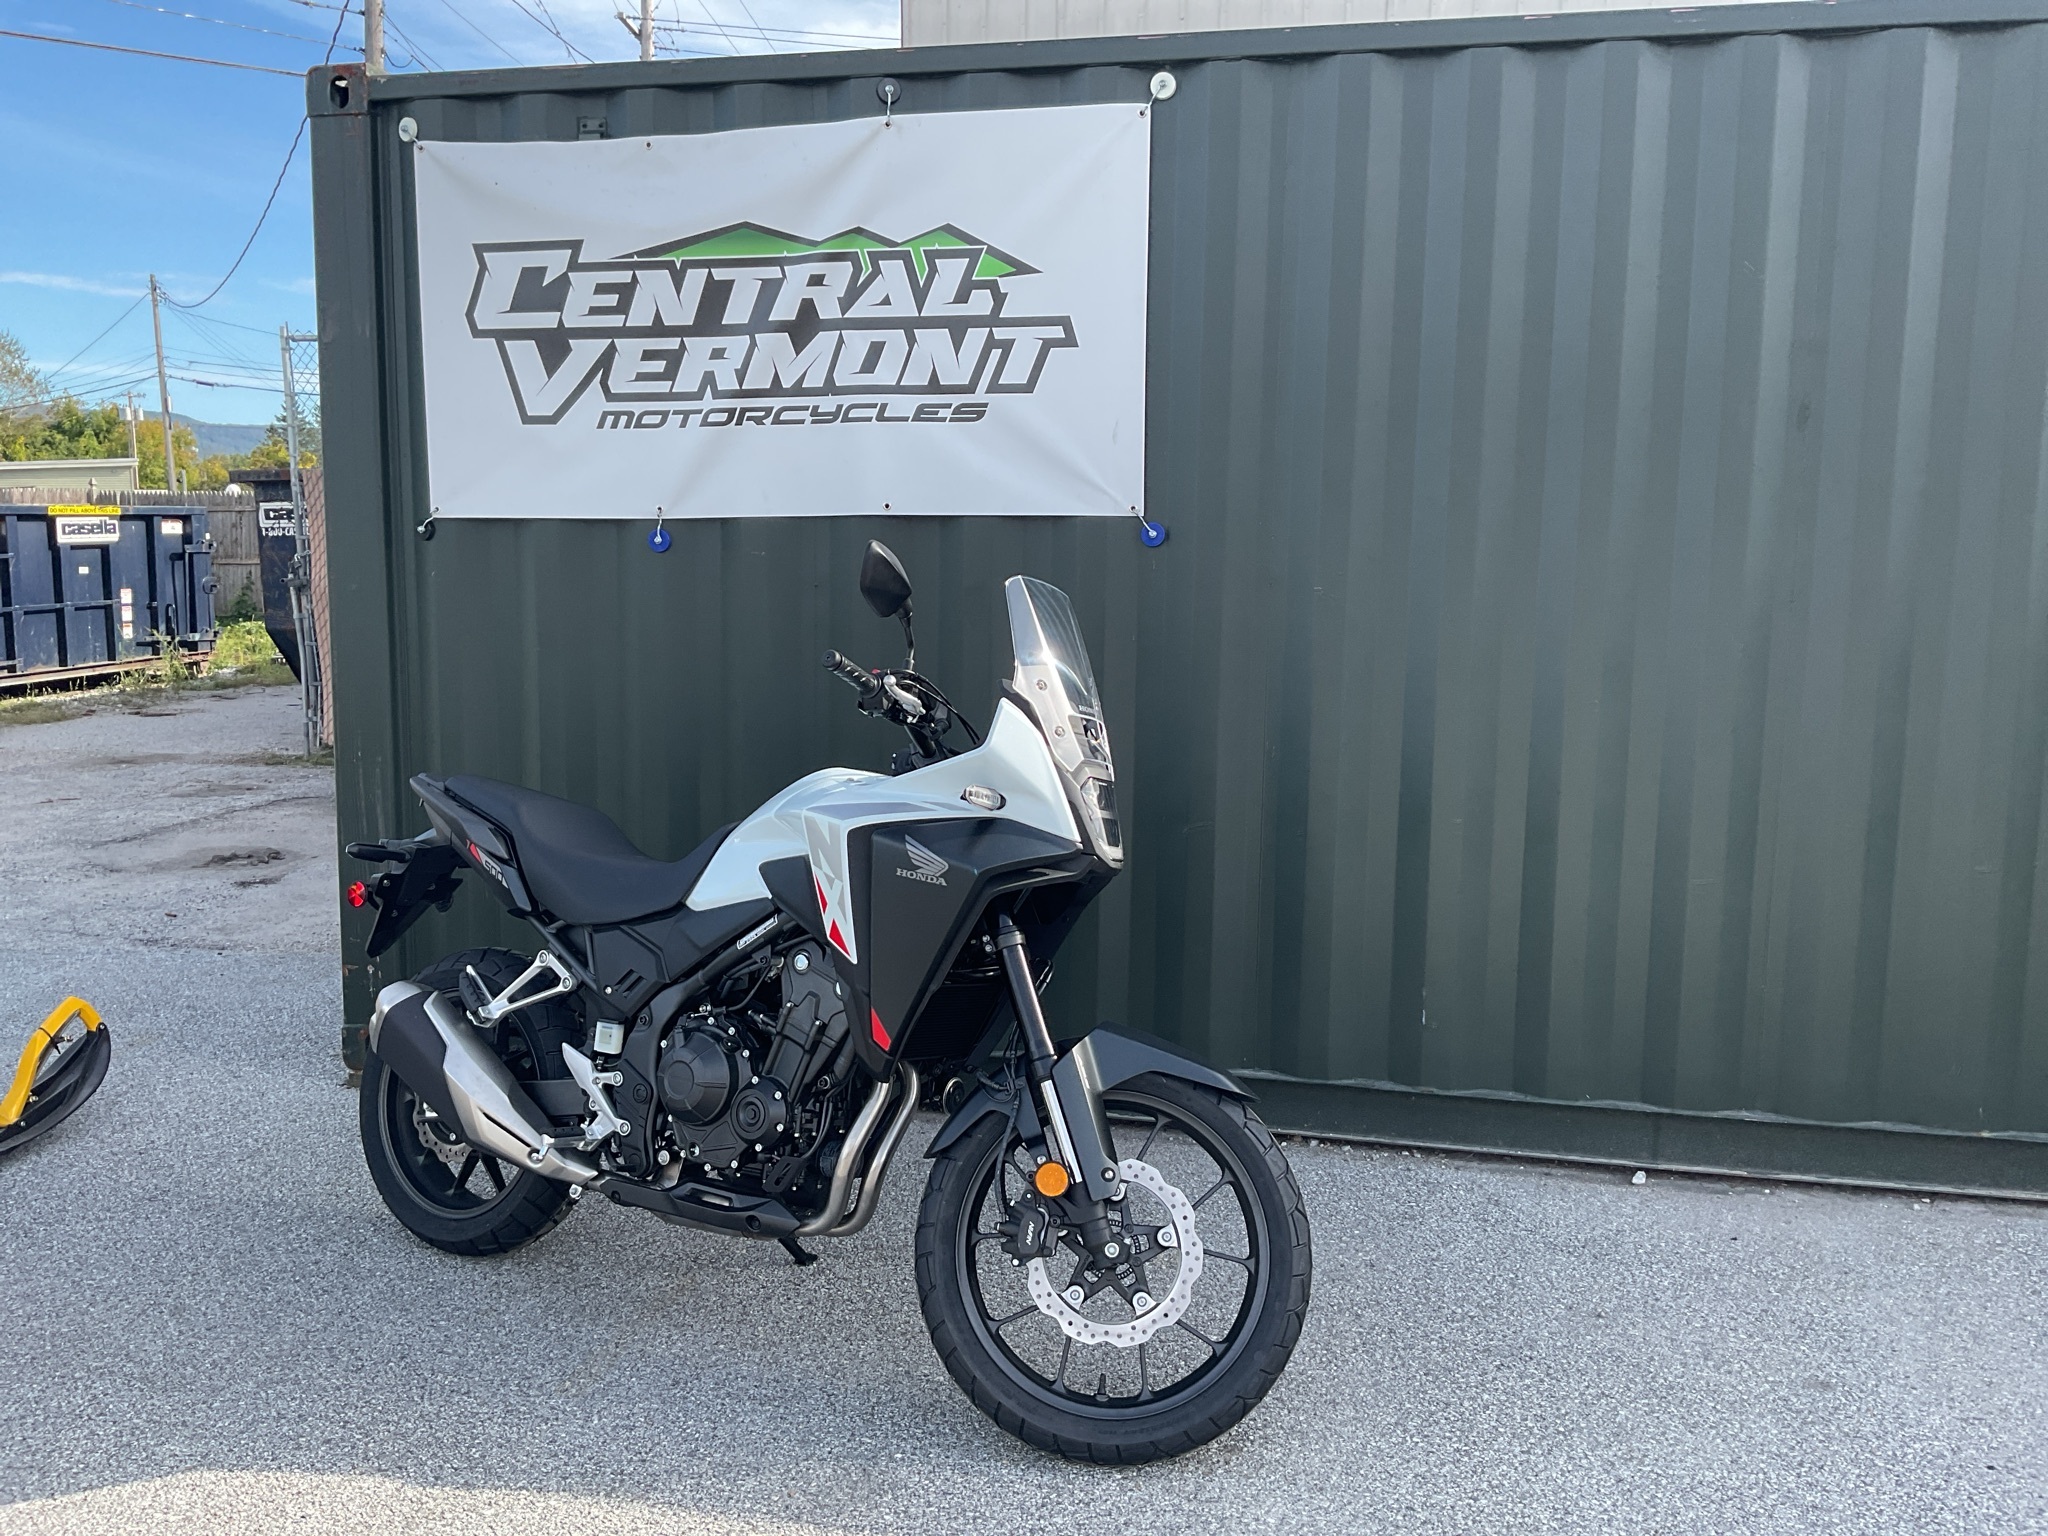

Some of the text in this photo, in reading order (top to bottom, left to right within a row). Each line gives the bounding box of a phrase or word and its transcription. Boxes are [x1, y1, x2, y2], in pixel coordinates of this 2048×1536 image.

[468, 242, 1002, 331] CENTRAL
[500, 326, 1076, 422] VERMONT
[597, 402, 988, 430] MOTORCYCLES
[61, 519, 117, 535] casella
[895, 867, 947, 886] HONDA
